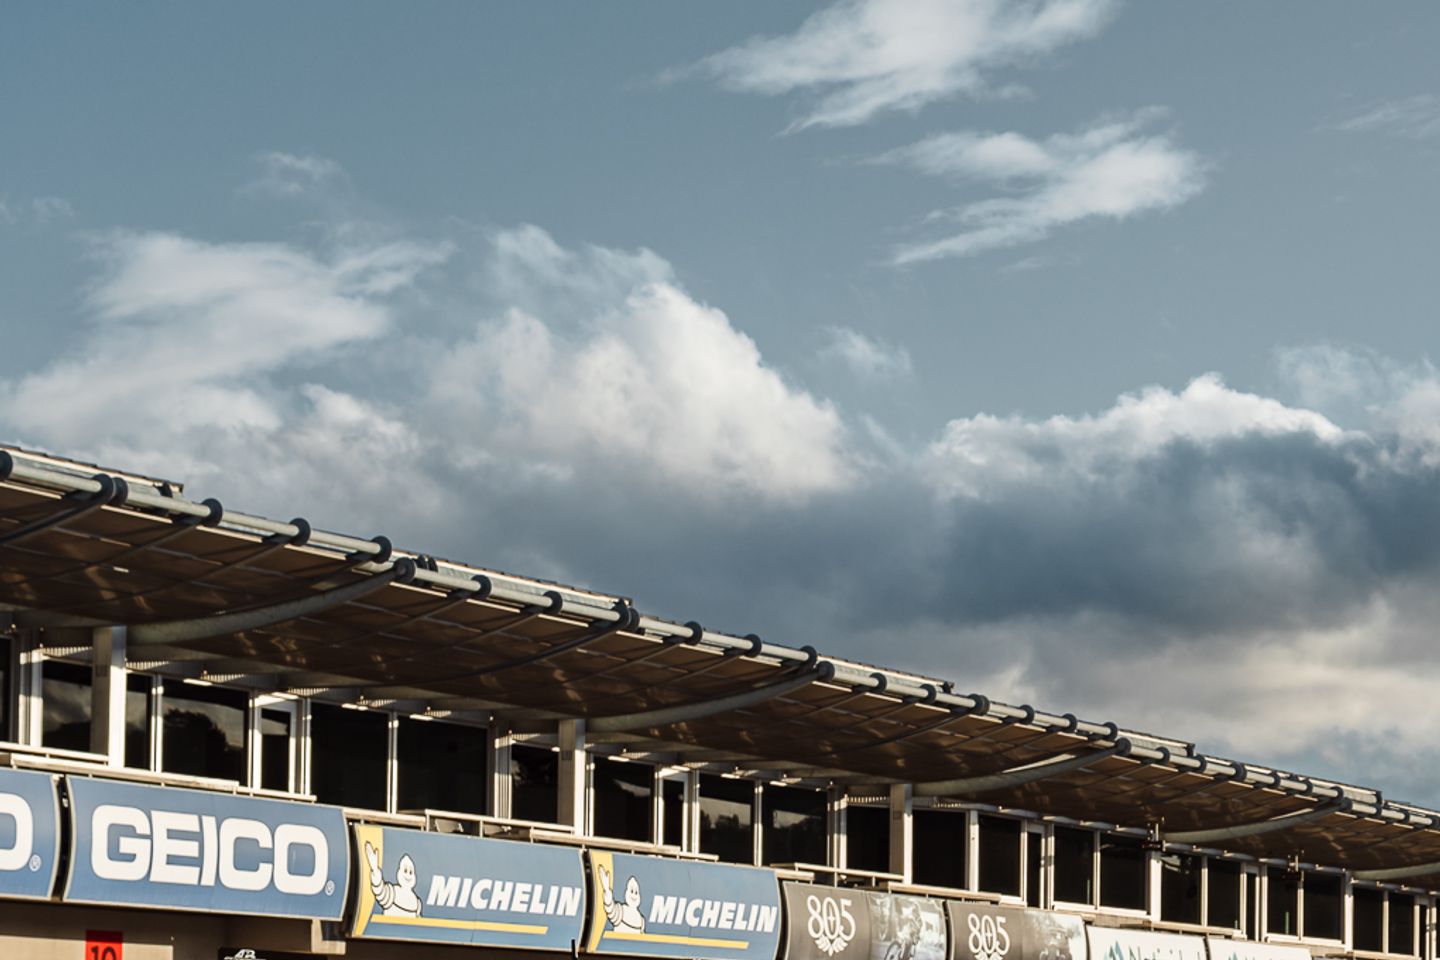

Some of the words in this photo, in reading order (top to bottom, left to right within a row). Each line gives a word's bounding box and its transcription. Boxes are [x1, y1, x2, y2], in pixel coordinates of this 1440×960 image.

[426, 874, 581, 918] MICHELIN
[648, 895, 777, 933] MICHELIN
[806, 895, 856, 941] 805
[968, 913, 1010, 955] 805
